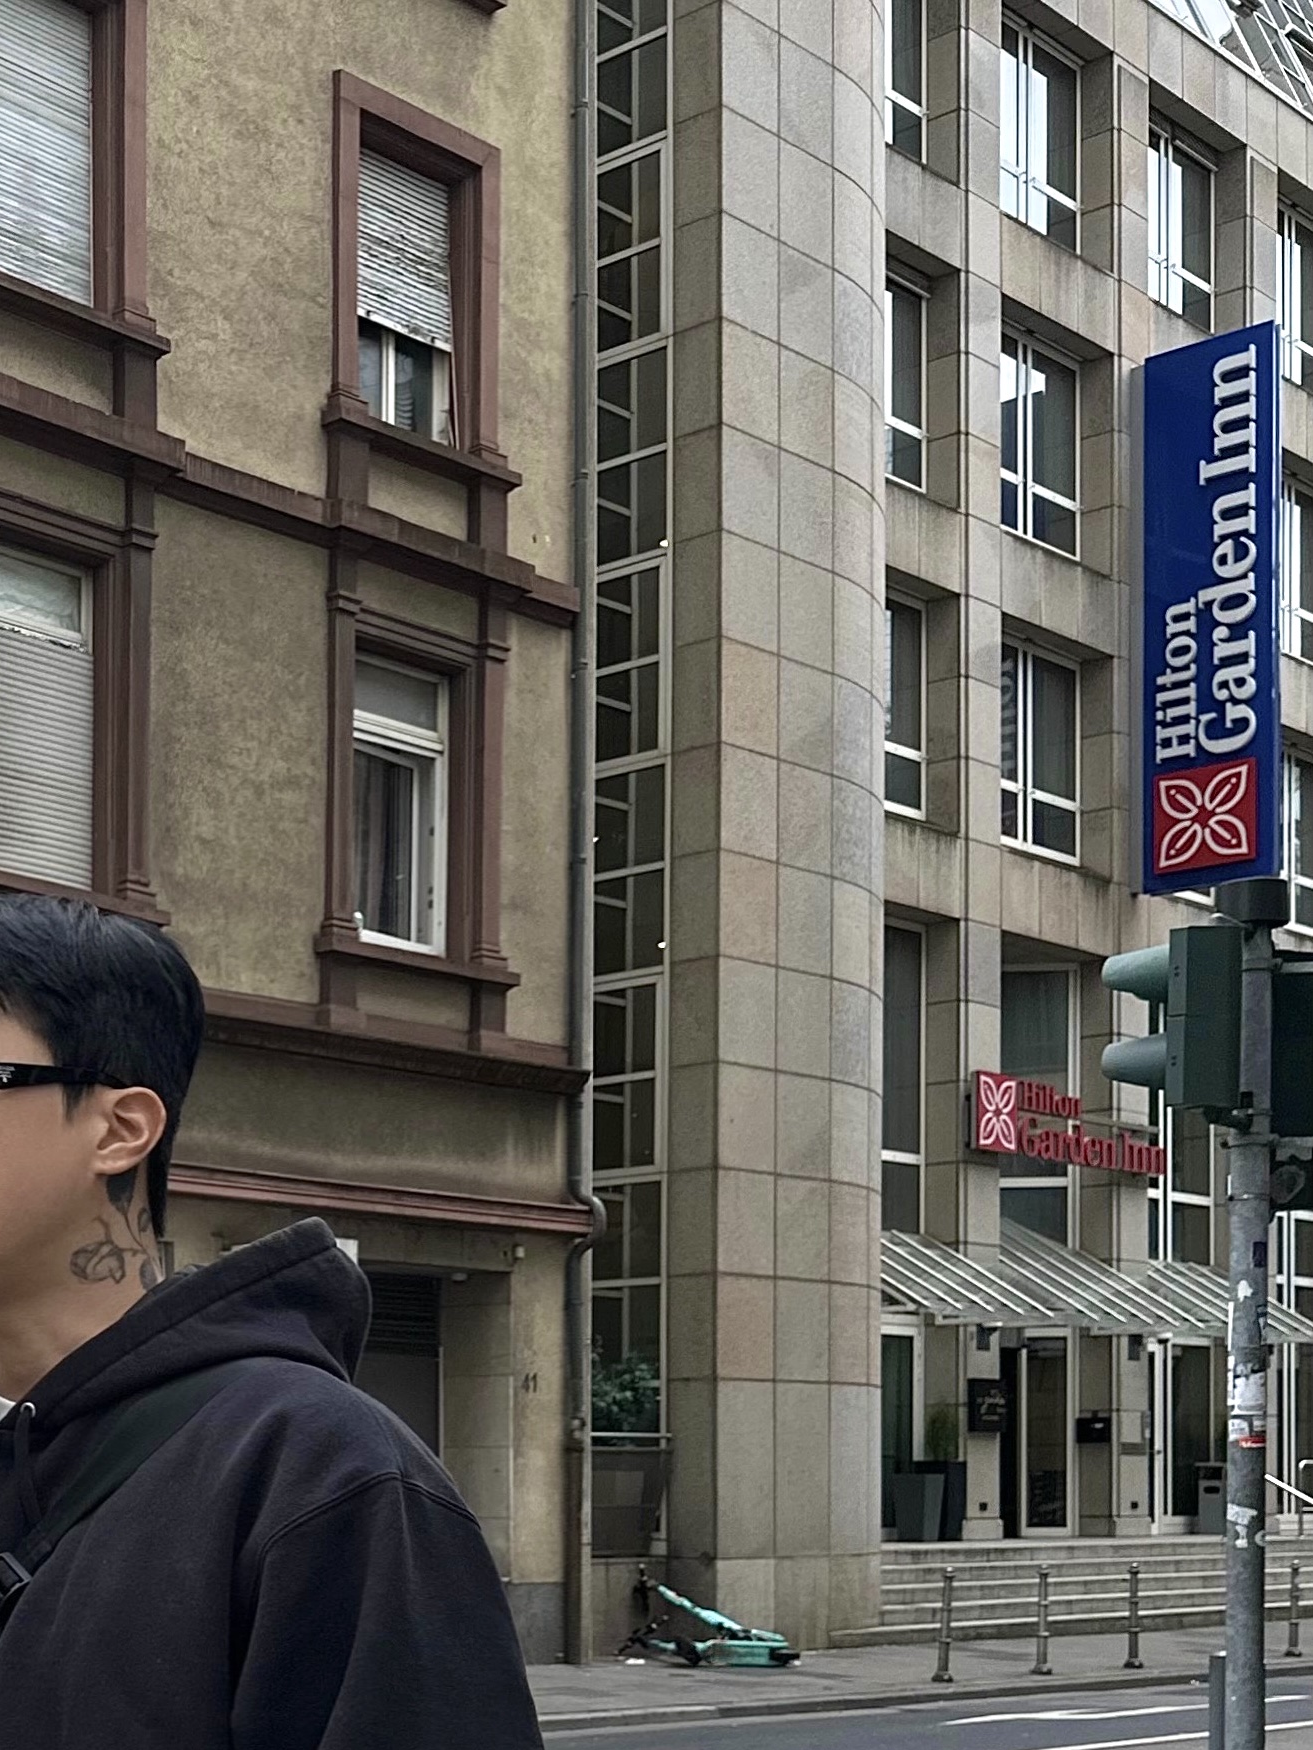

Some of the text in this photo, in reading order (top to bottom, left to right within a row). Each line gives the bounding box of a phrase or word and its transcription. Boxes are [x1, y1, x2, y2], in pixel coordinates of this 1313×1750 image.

[1198, 344, 1257, 755] Garden Inn
[1156, 597, 1197, 764] Hilton
[1021, 1080, 1081, 1118] Hilton
[1020, 1116, 1167, 1175] Garden Inn
[521, 1372, 538, 1393] 41
